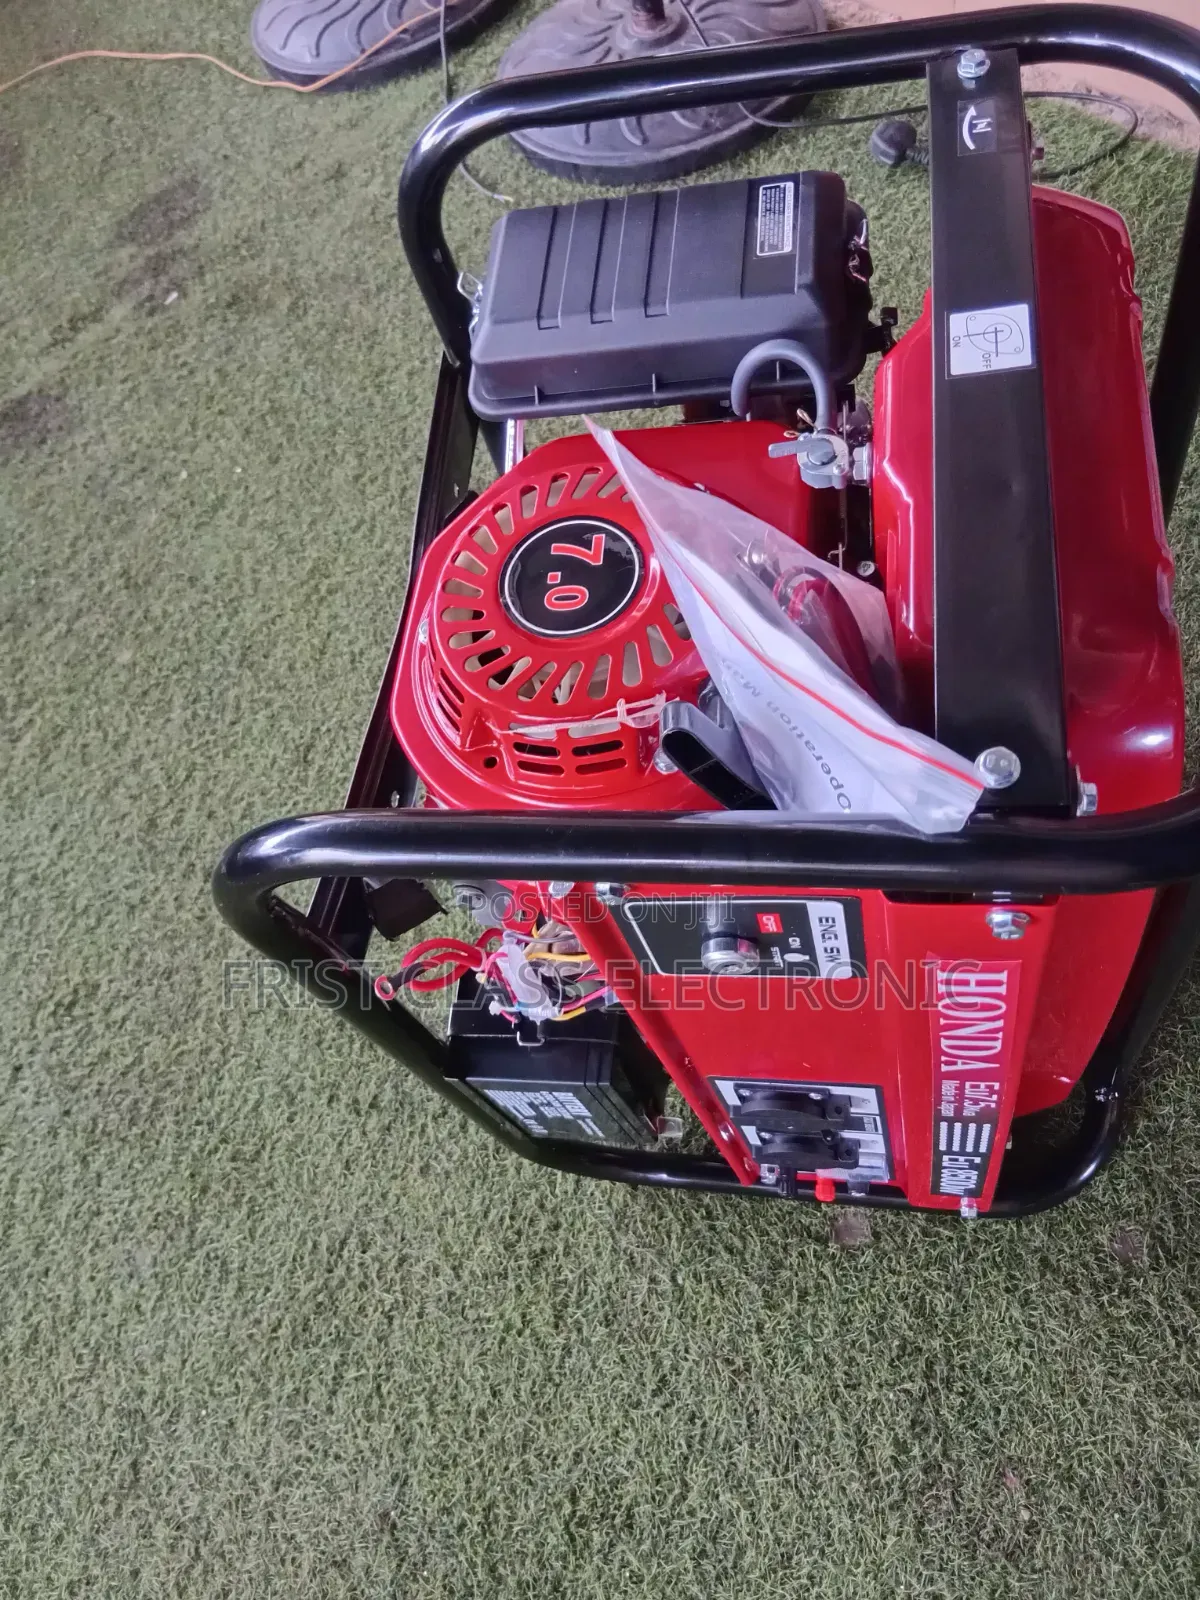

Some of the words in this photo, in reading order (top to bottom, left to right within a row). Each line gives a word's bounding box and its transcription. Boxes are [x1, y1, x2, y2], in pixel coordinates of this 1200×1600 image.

[952, 335, 963, 348] ON
[981, 352, 992, 369] OFF
[544, 533, 606, 611] 7.0
[766, 700, 852, 811] Operation
[762, 915, 777, 933] OFF
[817, 916, 840, 944] ENG.
[788, 936, 802, 949] ON
[769, 946, 784, 968] START
[823, 946, 842, 965] SW
[937, 970, 1007, 1072] HONDA
[942, 1080, 960, 1095] Made
[938, 1100, 956, 1117] Japan
[942, 1155, 981, 1168] Eu
